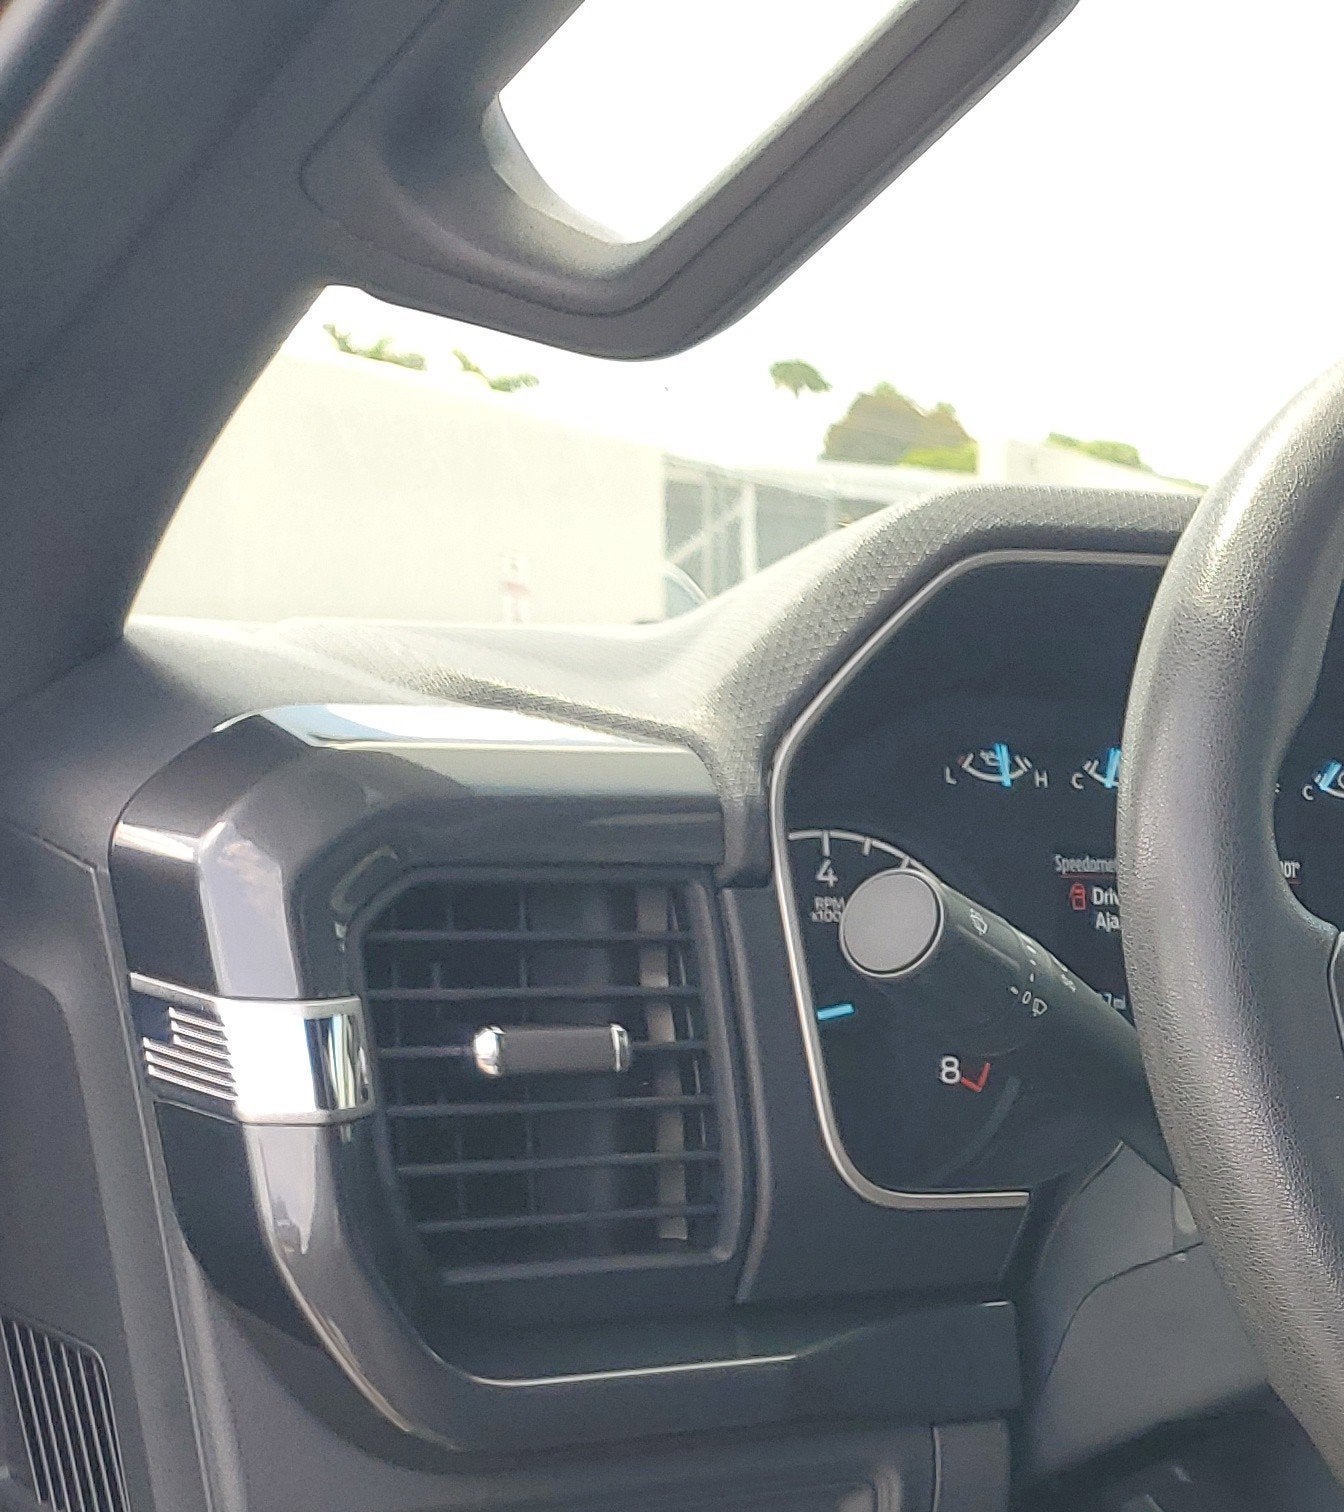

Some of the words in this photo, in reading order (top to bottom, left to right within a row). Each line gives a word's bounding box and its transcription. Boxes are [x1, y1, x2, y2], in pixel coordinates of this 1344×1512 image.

[945, 766, 957, 785] L
[1034, 770, 1049, 788] H
[1071, 772, 1084, 790] C
[1302, 784, 1315, 801] C
[815, 859, 839, 888] 4
[1055, 853, 1118, 875] Speedome
[1095, 911, 1120, 933] Aja
[941, 1055, 961, 1085] 8
